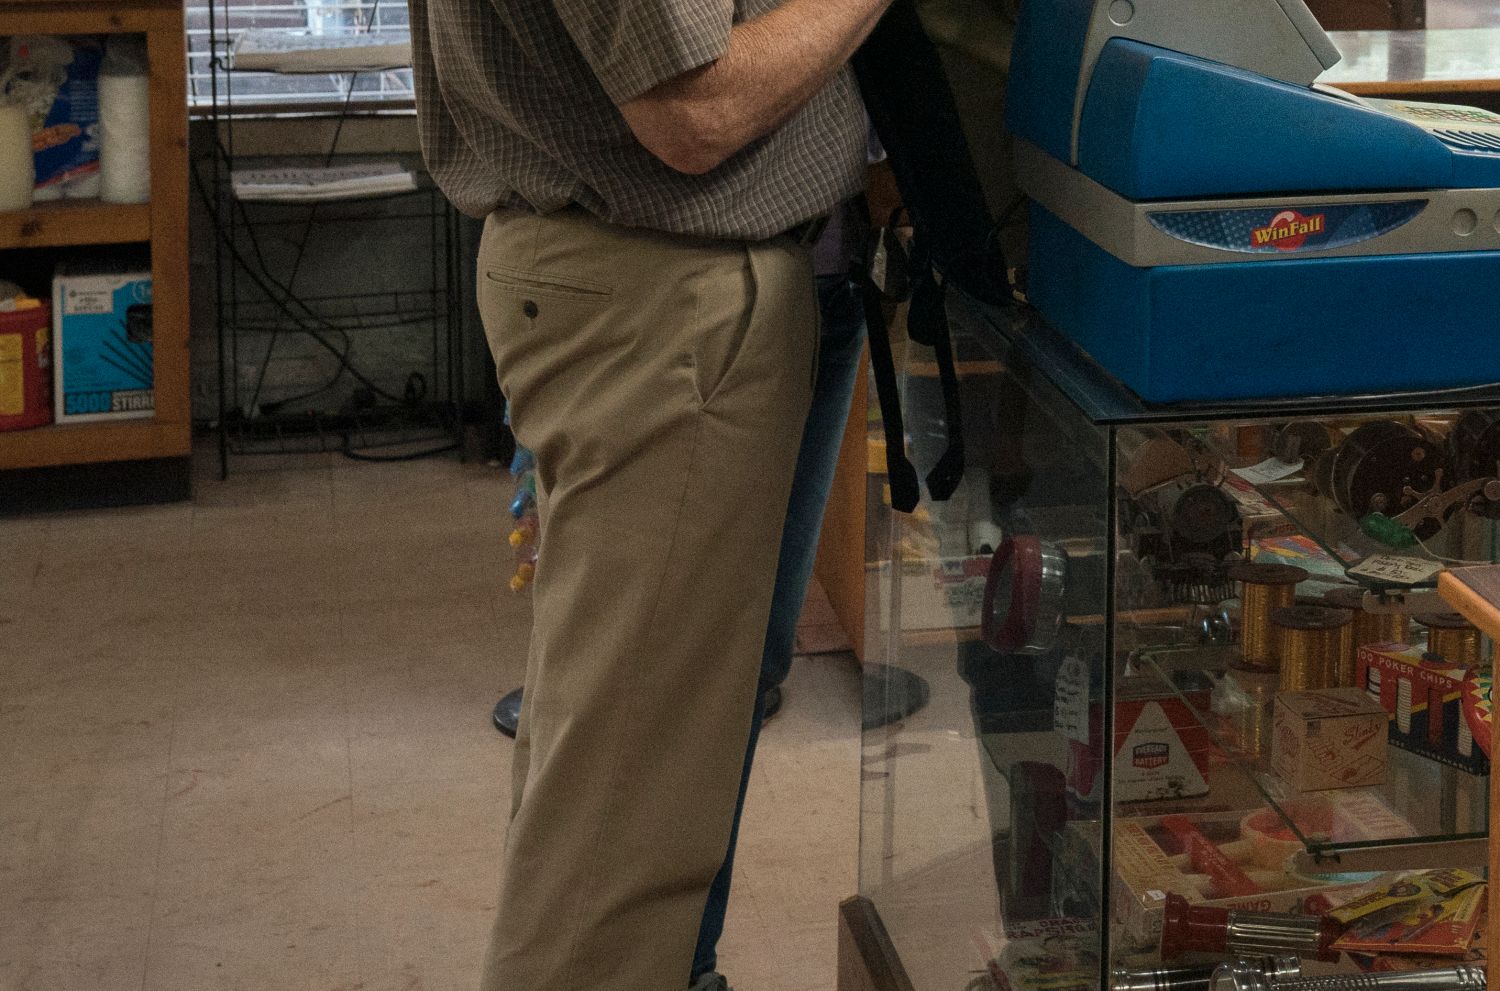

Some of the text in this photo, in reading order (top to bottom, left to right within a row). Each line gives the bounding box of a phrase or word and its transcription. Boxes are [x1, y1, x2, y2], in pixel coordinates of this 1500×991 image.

[1255, 216, 1321, 244] WinFall
[1357, 649, 1453, 689] 100 POKER CHIPS
